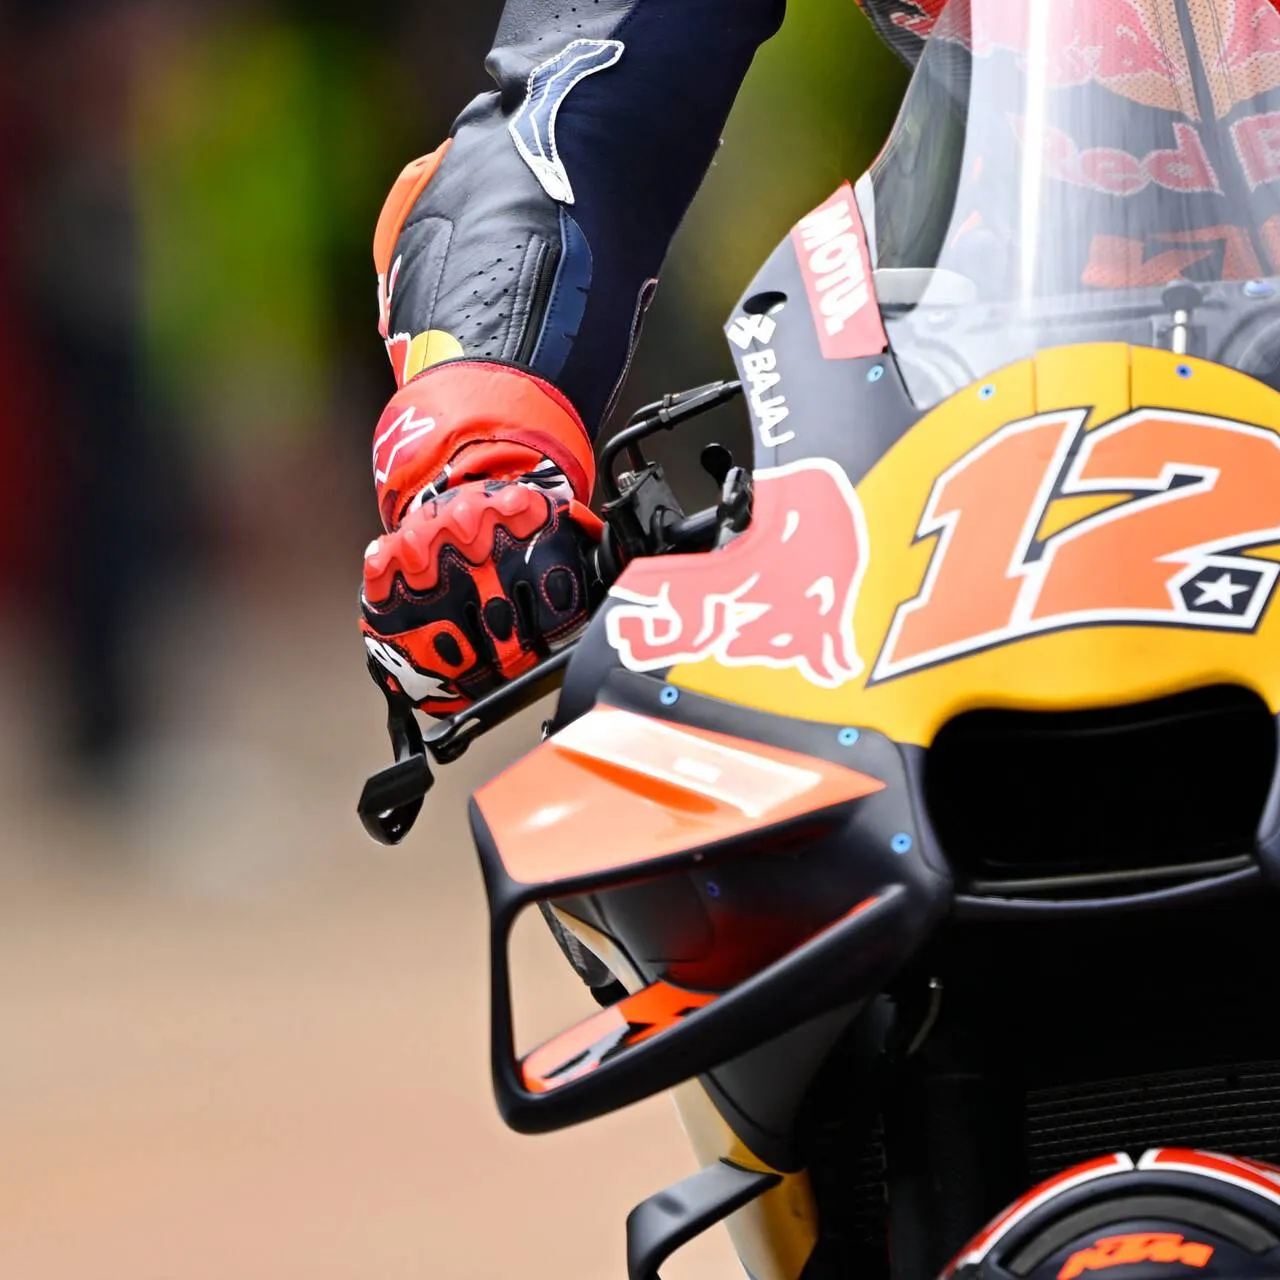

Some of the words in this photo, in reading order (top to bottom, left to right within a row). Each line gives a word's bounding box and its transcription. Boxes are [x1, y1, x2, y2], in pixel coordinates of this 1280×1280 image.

[1005, 112, 1225, 197] Red
[797, 199, 870, 337] MOTUL
[740, 348, 796, 449] BAJAJ
[1057, 1231, 1215, 1280] KTM
